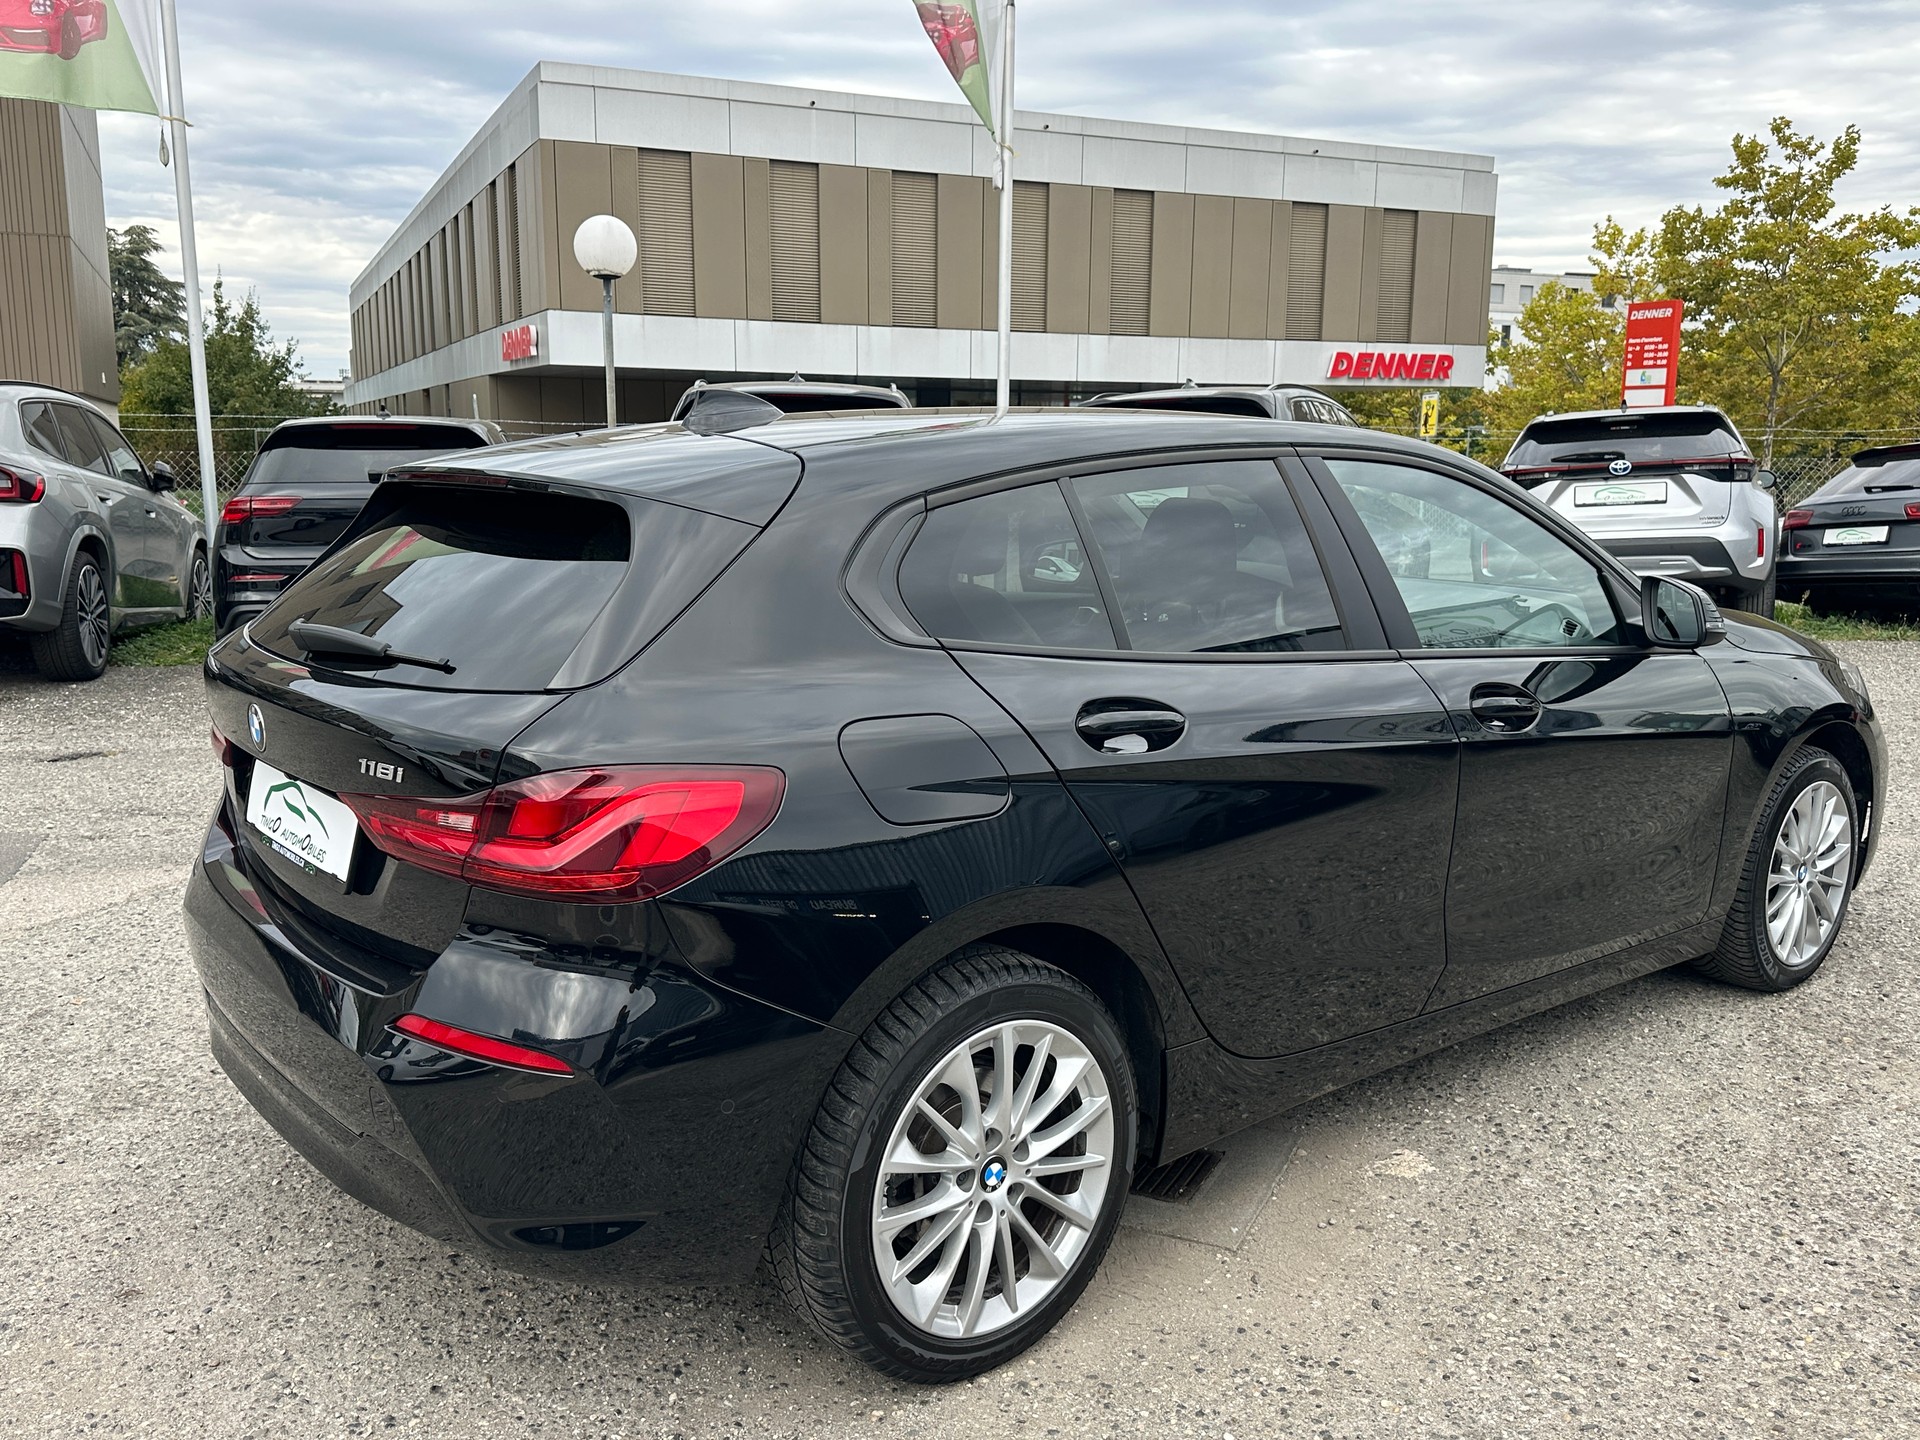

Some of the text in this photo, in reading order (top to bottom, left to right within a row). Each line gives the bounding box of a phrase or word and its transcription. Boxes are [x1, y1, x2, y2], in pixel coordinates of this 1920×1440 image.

[1630, 308, 1672, 320] DENNER
[502, 325, 537, 361] DENNER
[1327, 352, 1454, 379] DENNER
[359, 758, 404, 783] 118i
[260, 814, 281, 833] TINGO
[280, 828, 326, 863] AUTOMOBILES
